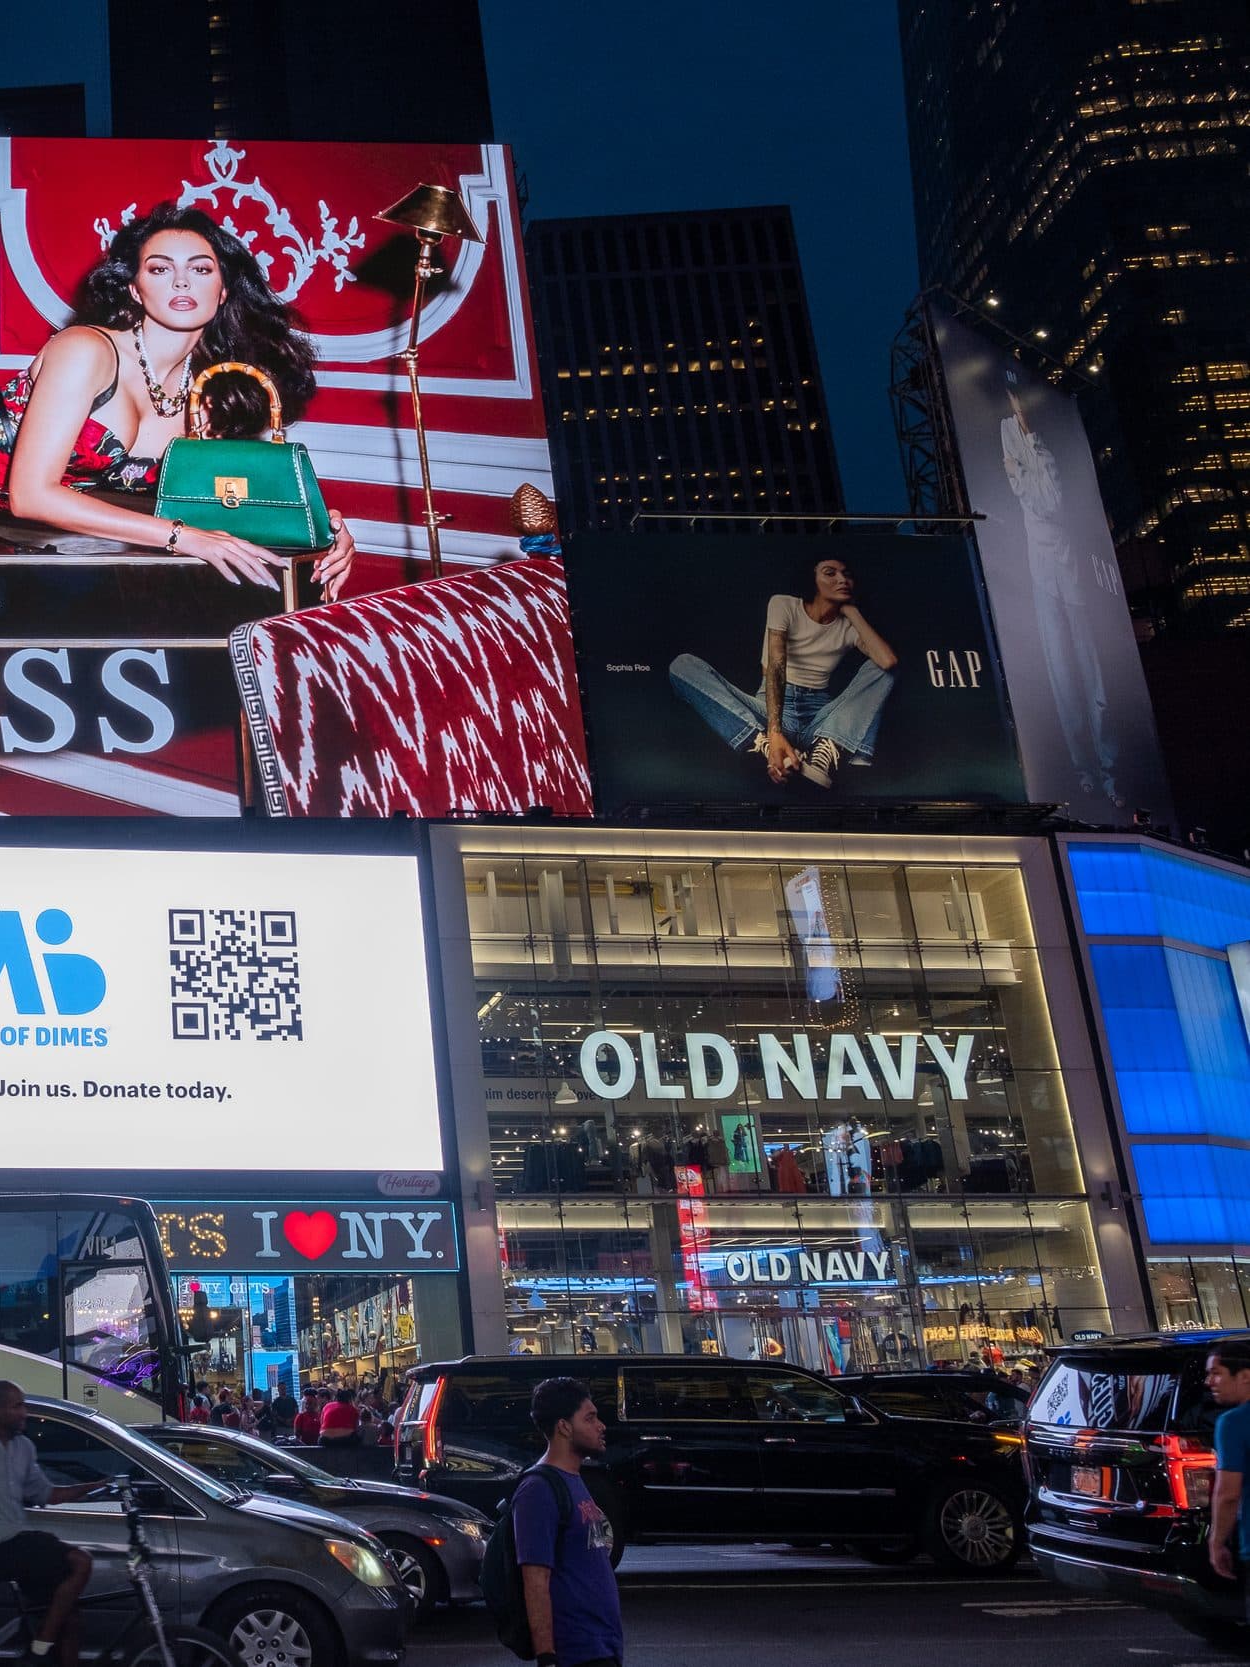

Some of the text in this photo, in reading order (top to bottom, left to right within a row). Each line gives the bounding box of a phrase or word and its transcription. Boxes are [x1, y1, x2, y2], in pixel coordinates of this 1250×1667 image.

[606, 664, 633, 672] Sophia
[926, 650, 982, 688] GAP
[0, 1026, 30, 1046] OF
[35, 1027, 108, 1047] DIMES
[579, 1031, 974, 1100] OLD NAVY
[46, 1083, 77, 1097] us.
[84, 1081, 161, 1098] Donate
[165, 1081, 232, 1103] today.
[252, 1211, 281, 1257] I
[86, 1236, 107, 1256] VIP
[726, 1252, 791, 1282] OLD
[800, 1251, 889, 1281] NAVY
[200, 1283, 221, 1294] NY
